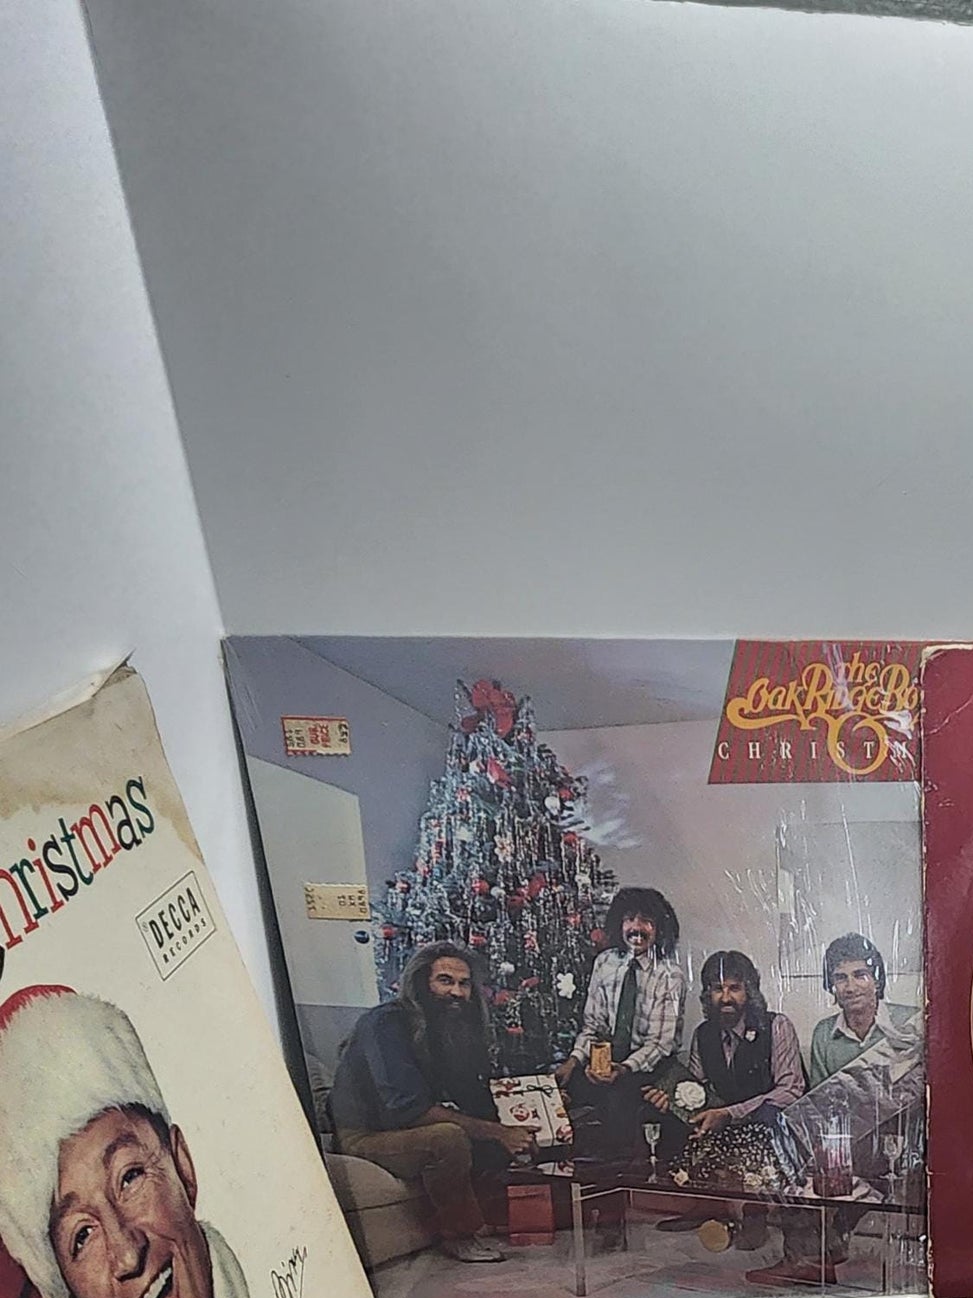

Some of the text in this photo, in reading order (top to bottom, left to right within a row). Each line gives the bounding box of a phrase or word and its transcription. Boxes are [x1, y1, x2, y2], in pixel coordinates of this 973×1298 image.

[0, 775, 155, 960] hristmas
[148, 887, 201, 949] DECCA
[162, 917, 207, 963] RECORDS
